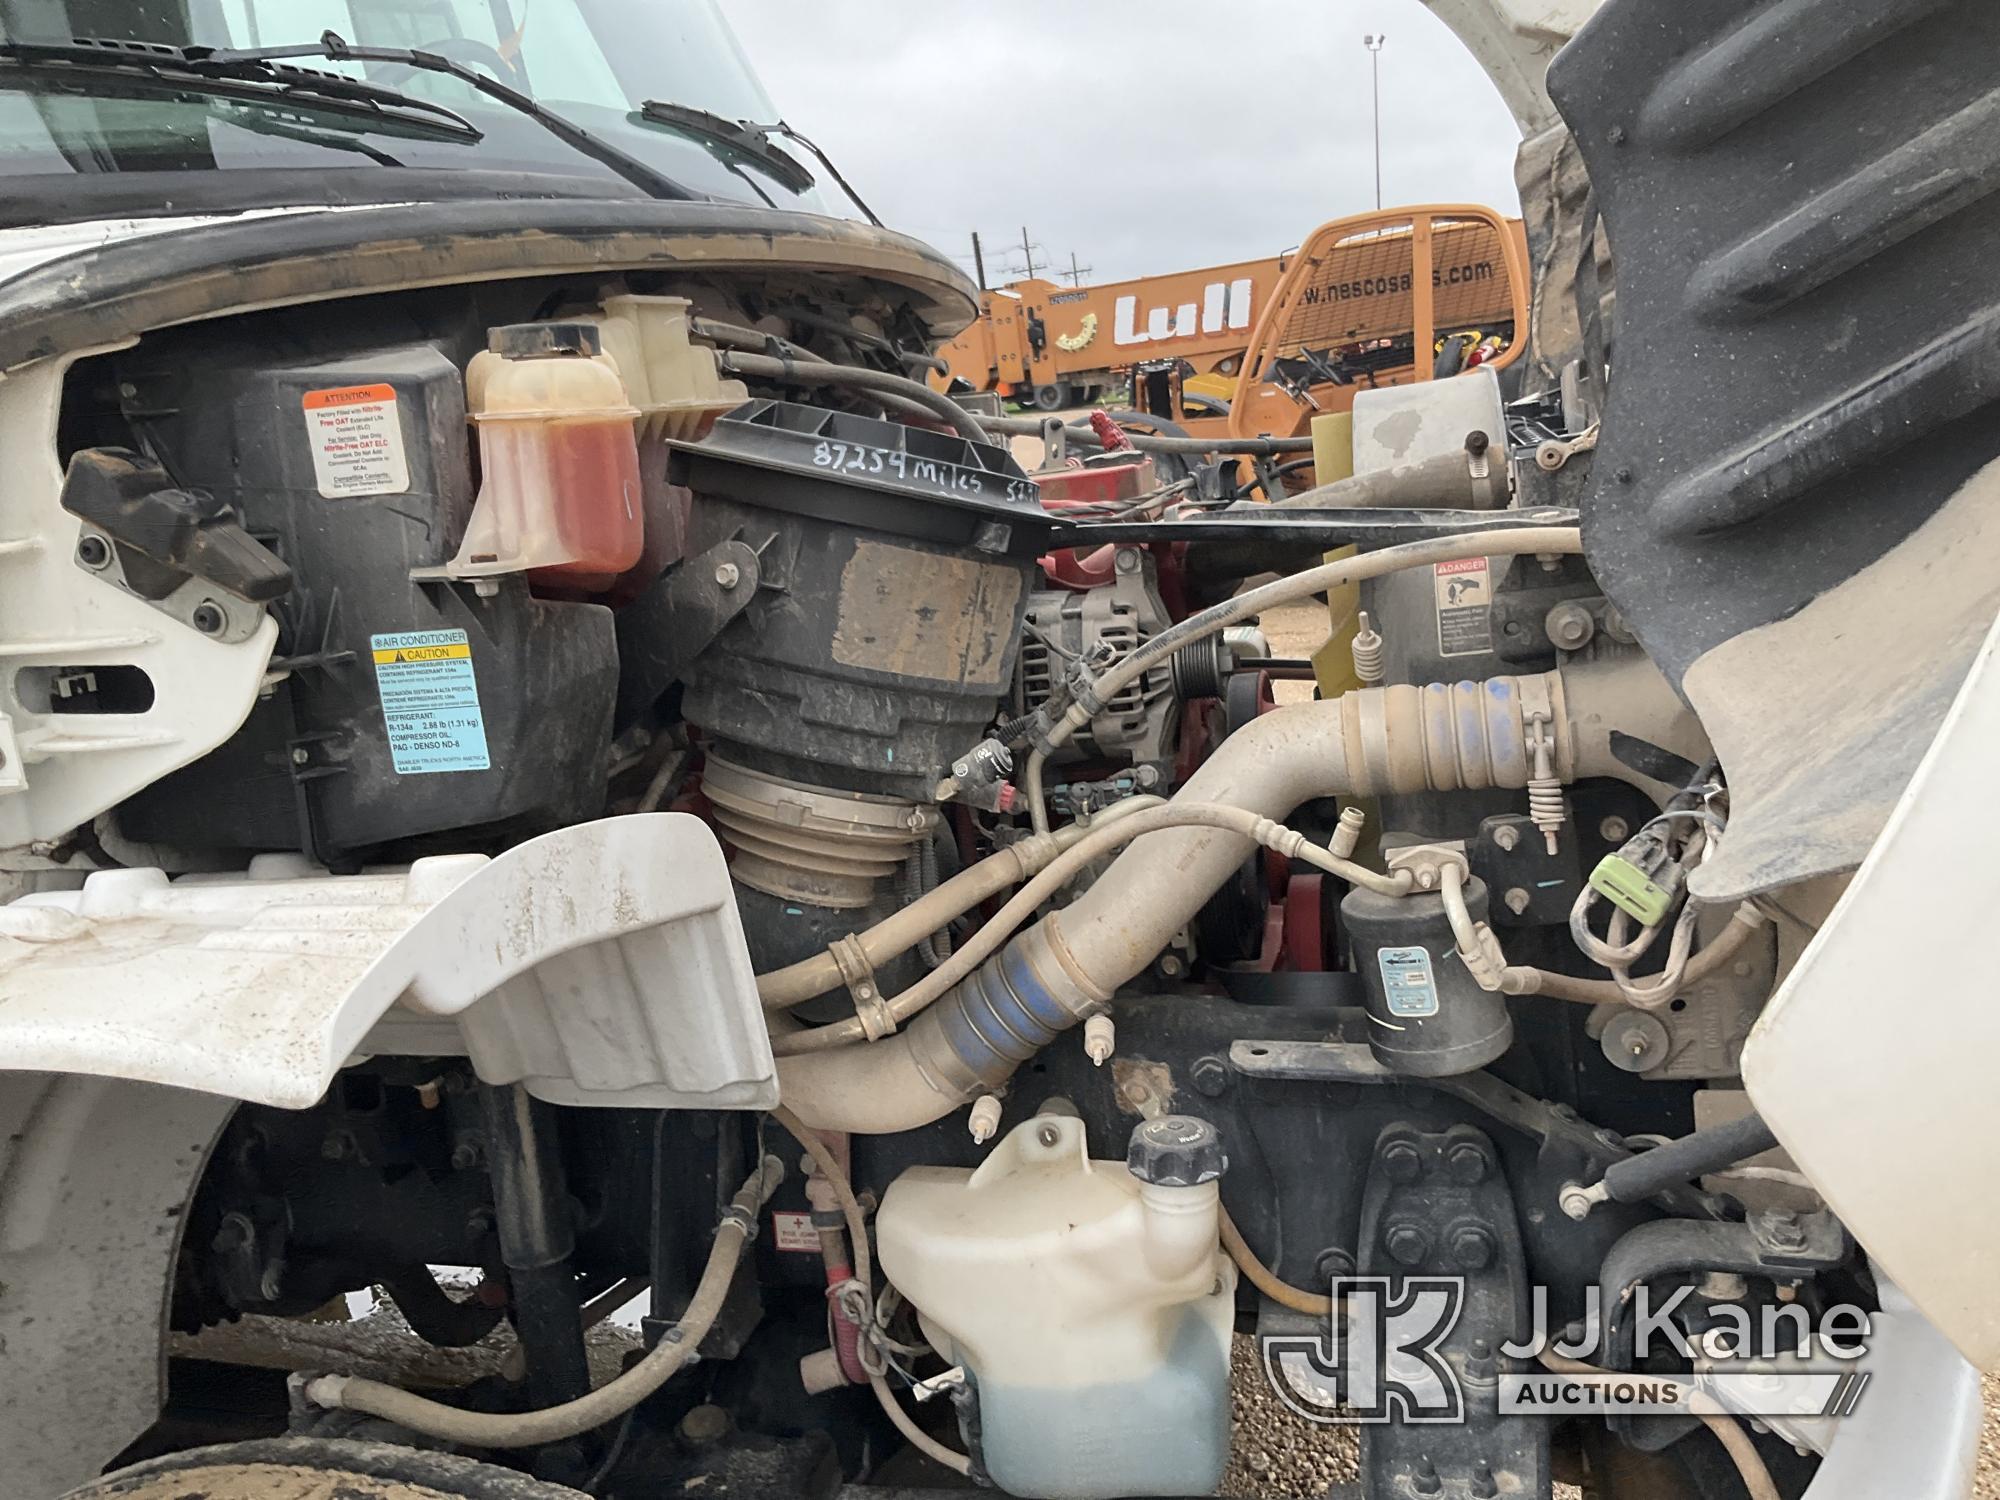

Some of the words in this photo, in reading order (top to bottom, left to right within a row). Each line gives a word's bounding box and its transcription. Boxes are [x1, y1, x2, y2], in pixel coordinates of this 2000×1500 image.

[1305, 260, 1493, 305] w.nescosas.com
[1113, 279, 1253, 346] Lull
[324, 391, 371, 403] ATTENTION
[317, 410, 335, 418] Factory
[337, 408, 350, 416] Filled
[350, 416, 373, 424] Extended
[356, 424, 370, 432] (ELC)
[324, 444, 358, 452] Nitrite-Free
[1447, 560, 1485, 573] DANGER
[383, 636, 399, 646] AIR
[400, 632, 466, 646] CONDITIONER
[408, 648, 449, 660] CAUTION
[416, 661, 444, 669] PRESSURE
[379, 670, 405, 678] CONTAINS
[406, 668, 444, 676] REFRIGERANT
[389, 723, 413, 732] R-134a
[439, 720, 447, 729] lb
[448, 719, 466, 729] (1.31
[467, 718, 479, 728] kg)
[391, 732, 438, 742] COMPRESSOR
[393, 743, 408, 751] PAG
[414, 742, 440, 750] DENSO
[441, 740, 460, 749] ND-8
